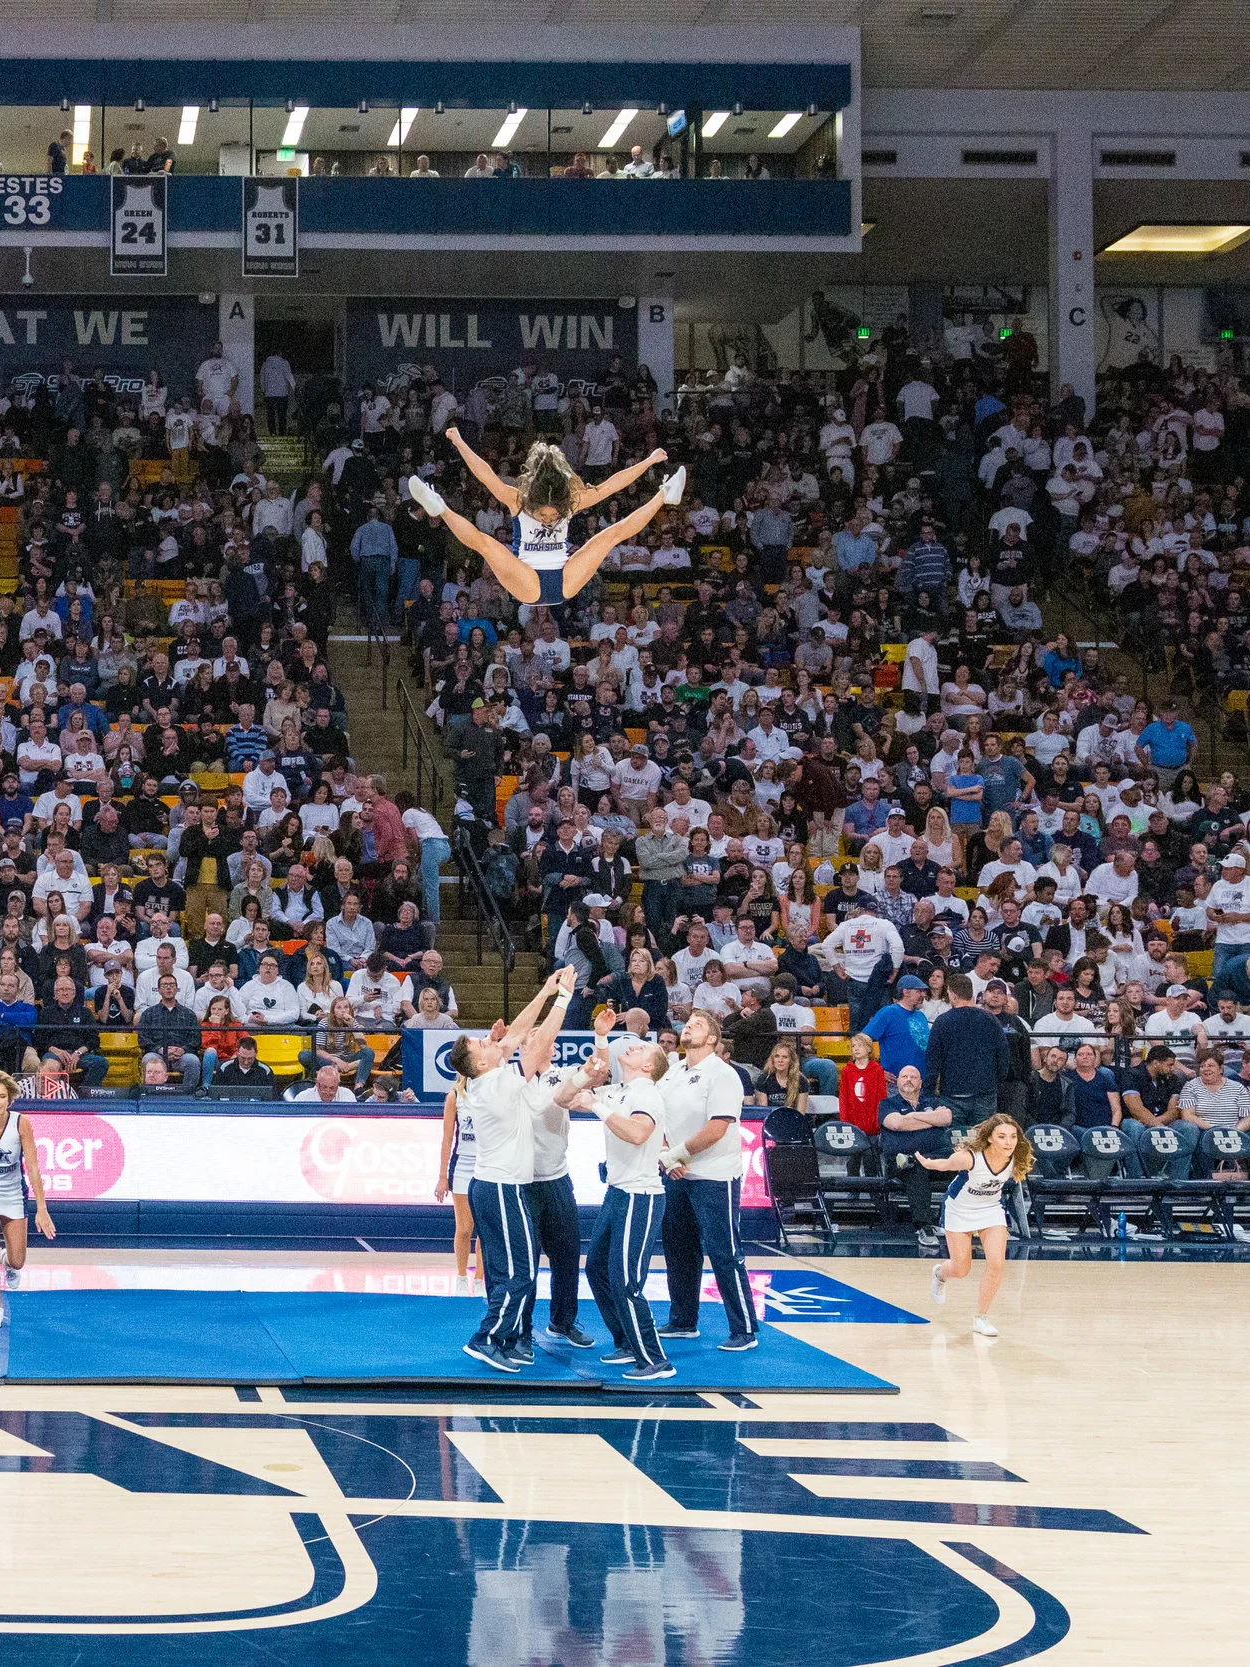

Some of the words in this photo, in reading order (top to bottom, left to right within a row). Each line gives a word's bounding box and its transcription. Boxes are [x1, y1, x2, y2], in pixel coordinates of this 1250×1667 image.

[3, 195, 51, 225] 33
[124, 210, 153, 218] GREEN
[251, 211, 290, 219] ROBERTS
[121, 222, 157, 244] 24
[255, 223, 285, 245] 31
[229, 301, 245, 320] A
[649, 305, 666, 324] B
[1068, 306, 1086, 326] C
[73, 310, 149, 345] WE
[377, 314, 492, 348] WILL
[519, 315, 614, 349] WIN
[524, 543, 544, 551] UTAH
[544, 542, 564, 551] STATE
[145, 903, 170, 912] STATE
[0, 1163, 17, 1174] STATE
